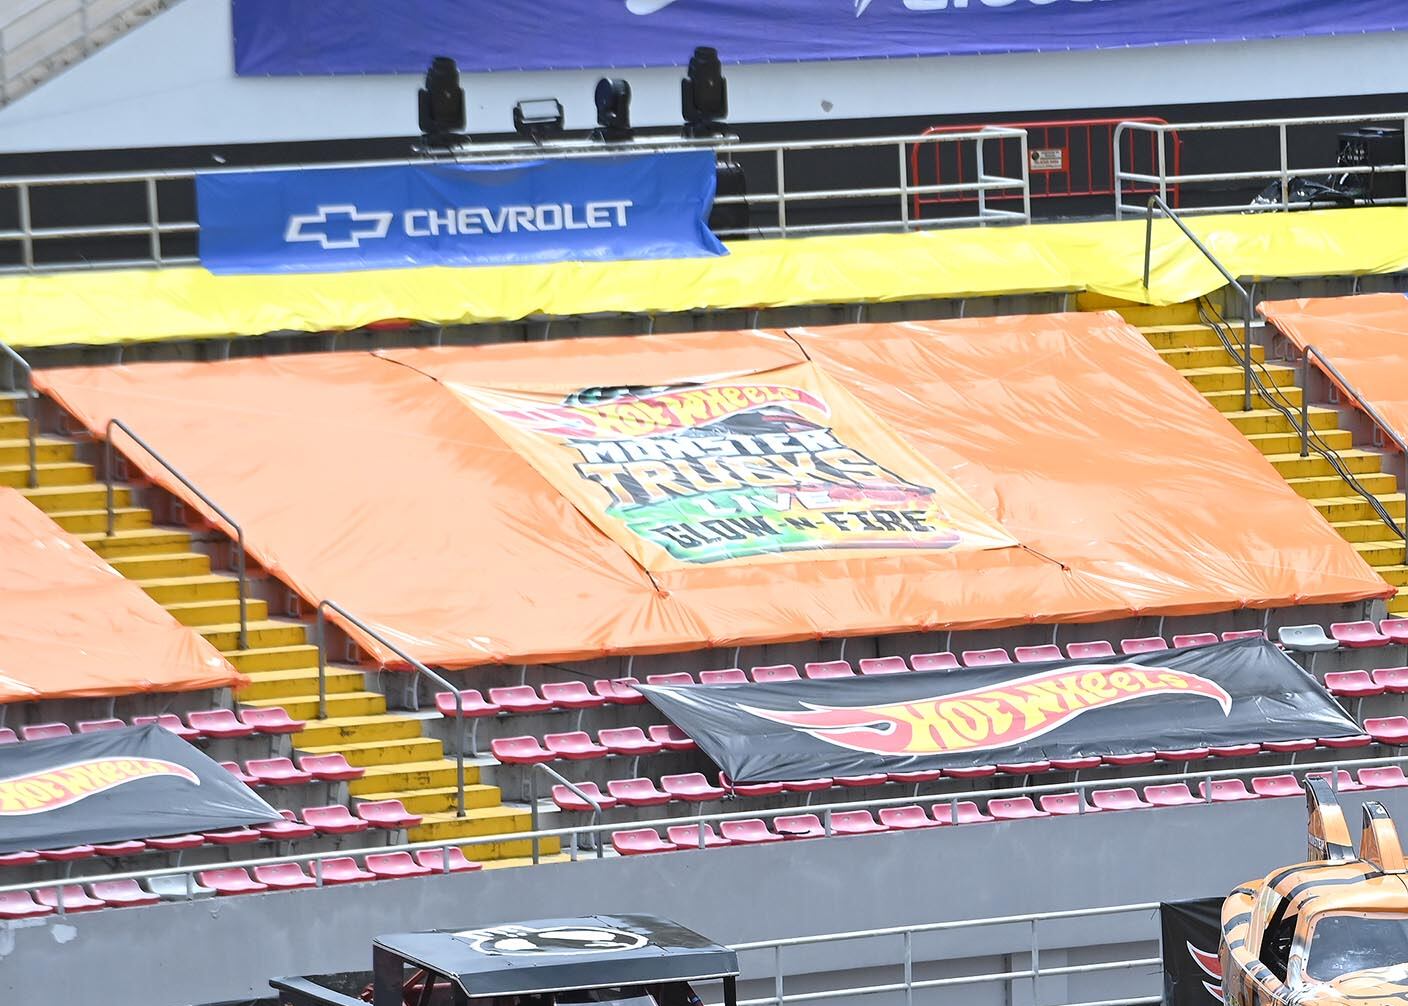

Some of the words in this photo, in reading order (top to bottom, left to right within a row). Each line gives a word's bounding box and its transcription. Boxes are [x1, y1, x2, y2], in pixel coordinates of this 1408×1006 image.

[402, 200, 633, 237] CHEVROLET
[577, 428, 841, 464] MONSTER
[582, 449, 900, 507] TRUCKS
